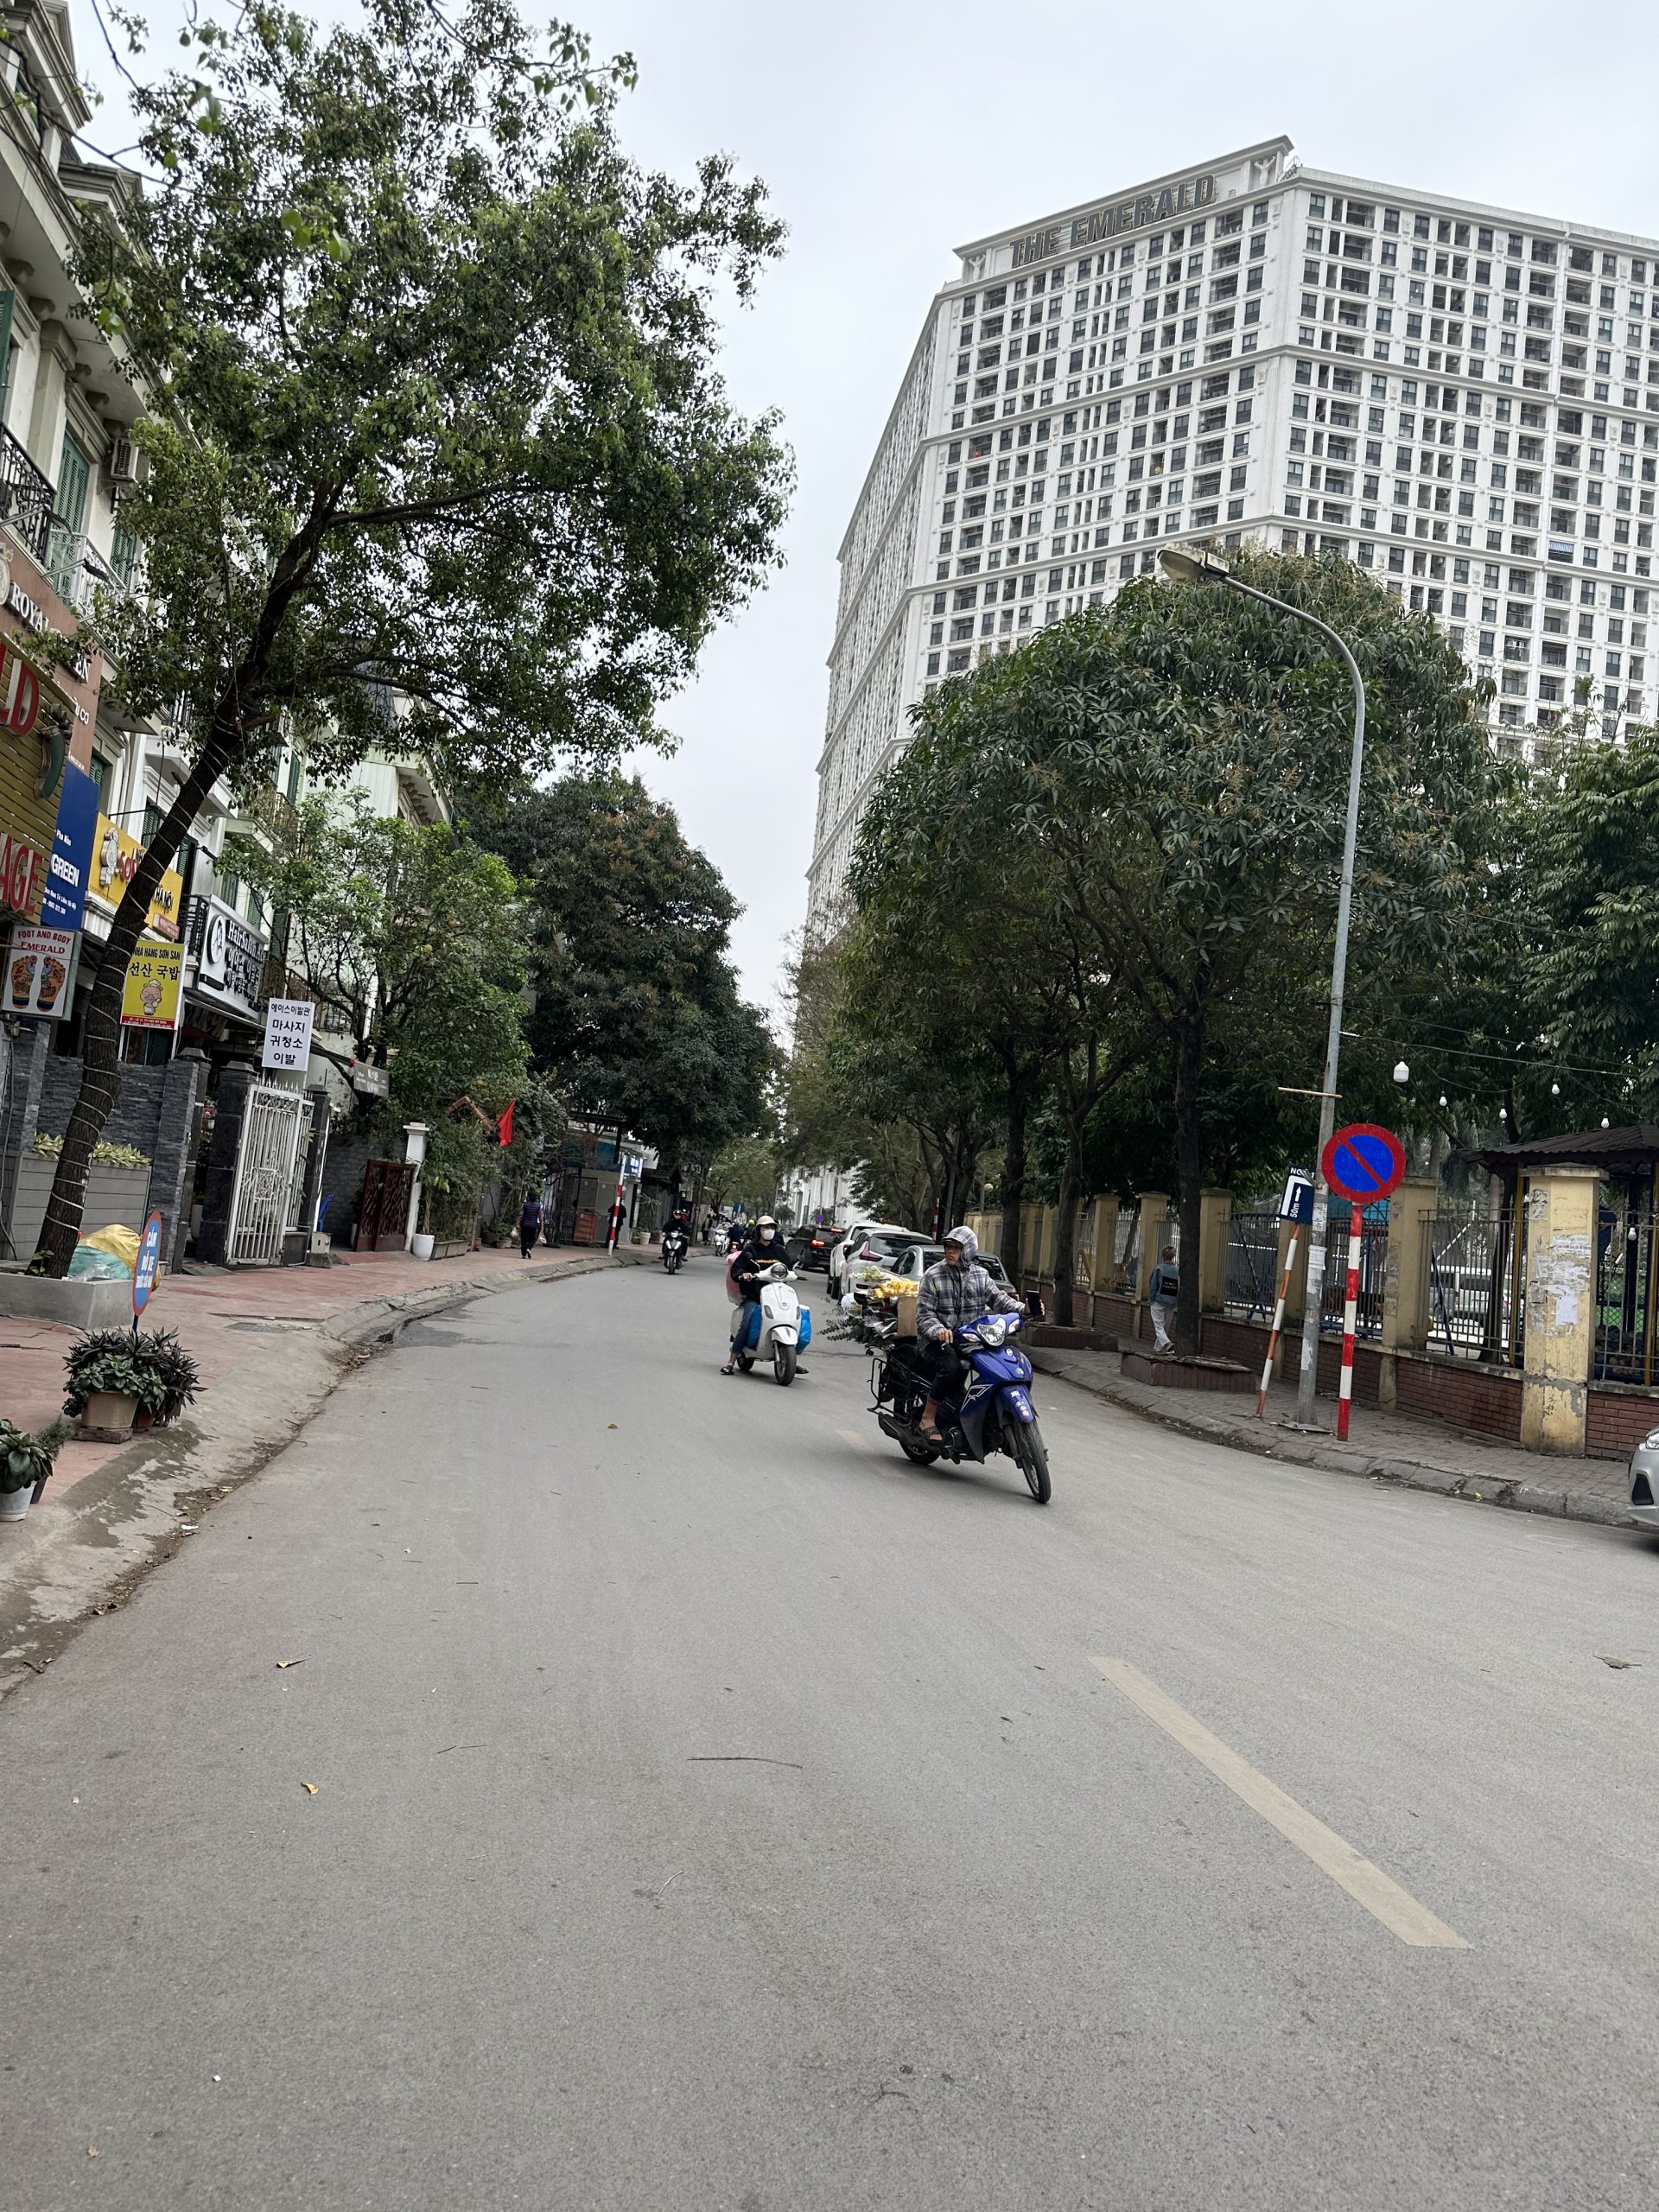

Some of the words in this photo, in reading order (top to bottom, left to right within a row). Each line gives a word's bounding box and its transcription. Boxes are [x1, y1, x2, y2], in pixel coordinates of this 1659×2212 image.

[1009, 226, 1061, 269] THE
[1070, 175, 1217, 250] EMERALD
[51, 853, 80, 887] GREEN
[18, 930, 35, 939] FOOT
[36, 930, 51, 939] AND
[53, 932, 71, 945] BODY
[21, 941, 66, 955] EMERALD
[129, 961, 153, 978] 선산
[156, 964, 181, 981] 국밥
[270, 1003, 311, 1017] 에이스이발관
[272, 1019, 305, 1033] 마사지
[270, 1034, 303, 1049] 귀청소
[273, 1052, 296, 1065] 이발
[1289, 1203, 1300, 1218] 50m
